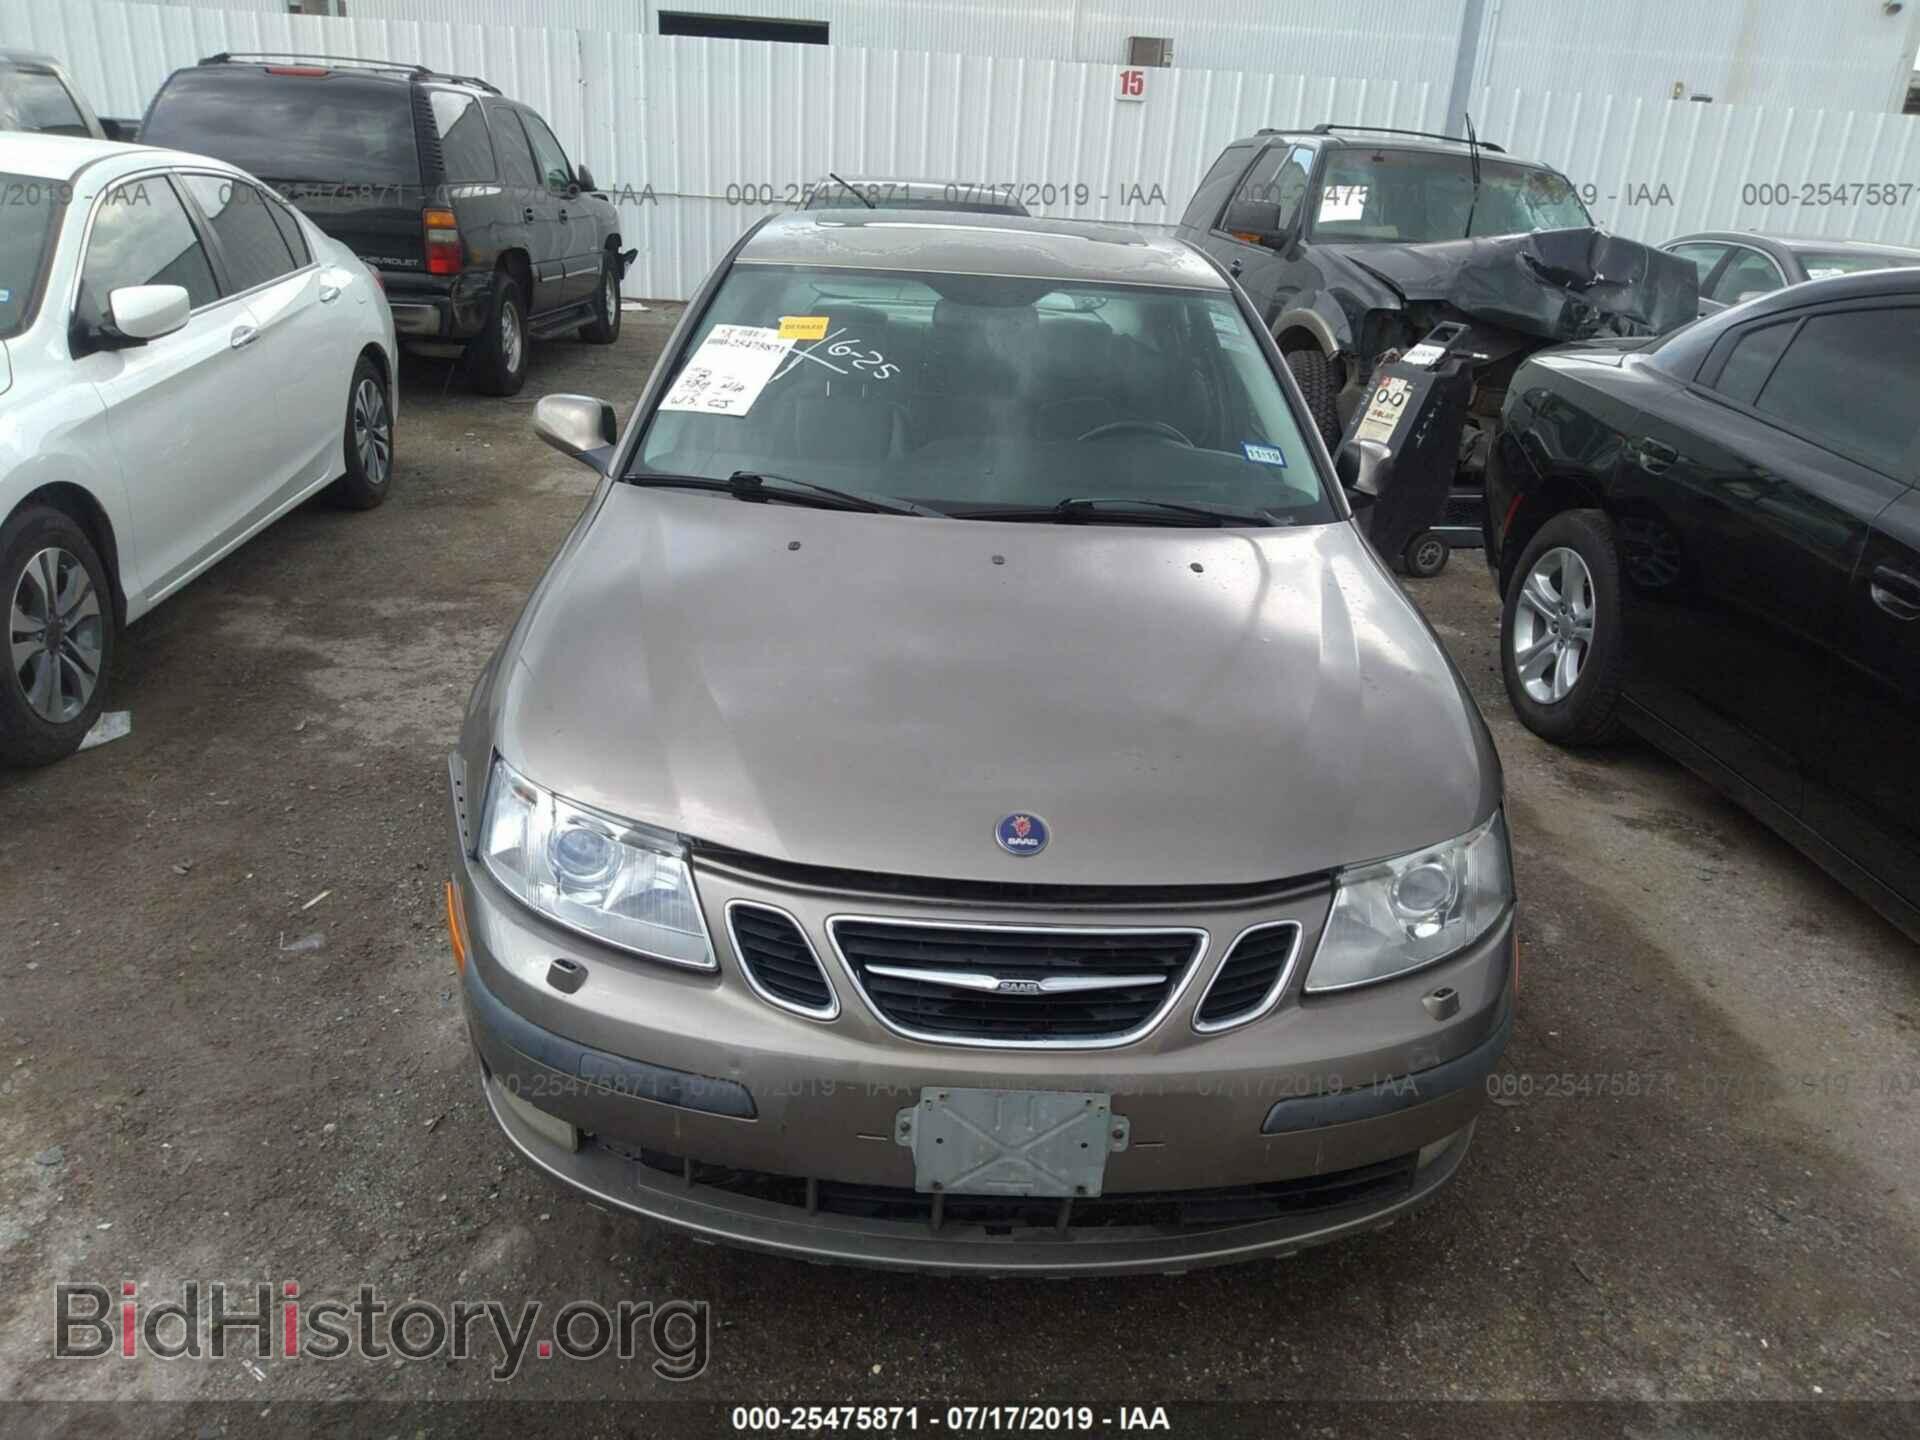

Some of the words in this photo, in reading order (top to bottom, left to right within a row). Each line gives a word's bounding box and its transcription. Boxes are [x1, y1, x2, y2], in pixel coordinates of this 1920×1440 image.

[1119, 70, 1144, 96] 15
[1007, 836, 1039, 846] SAAB
[999, 981, 1039, 992] SAAB
